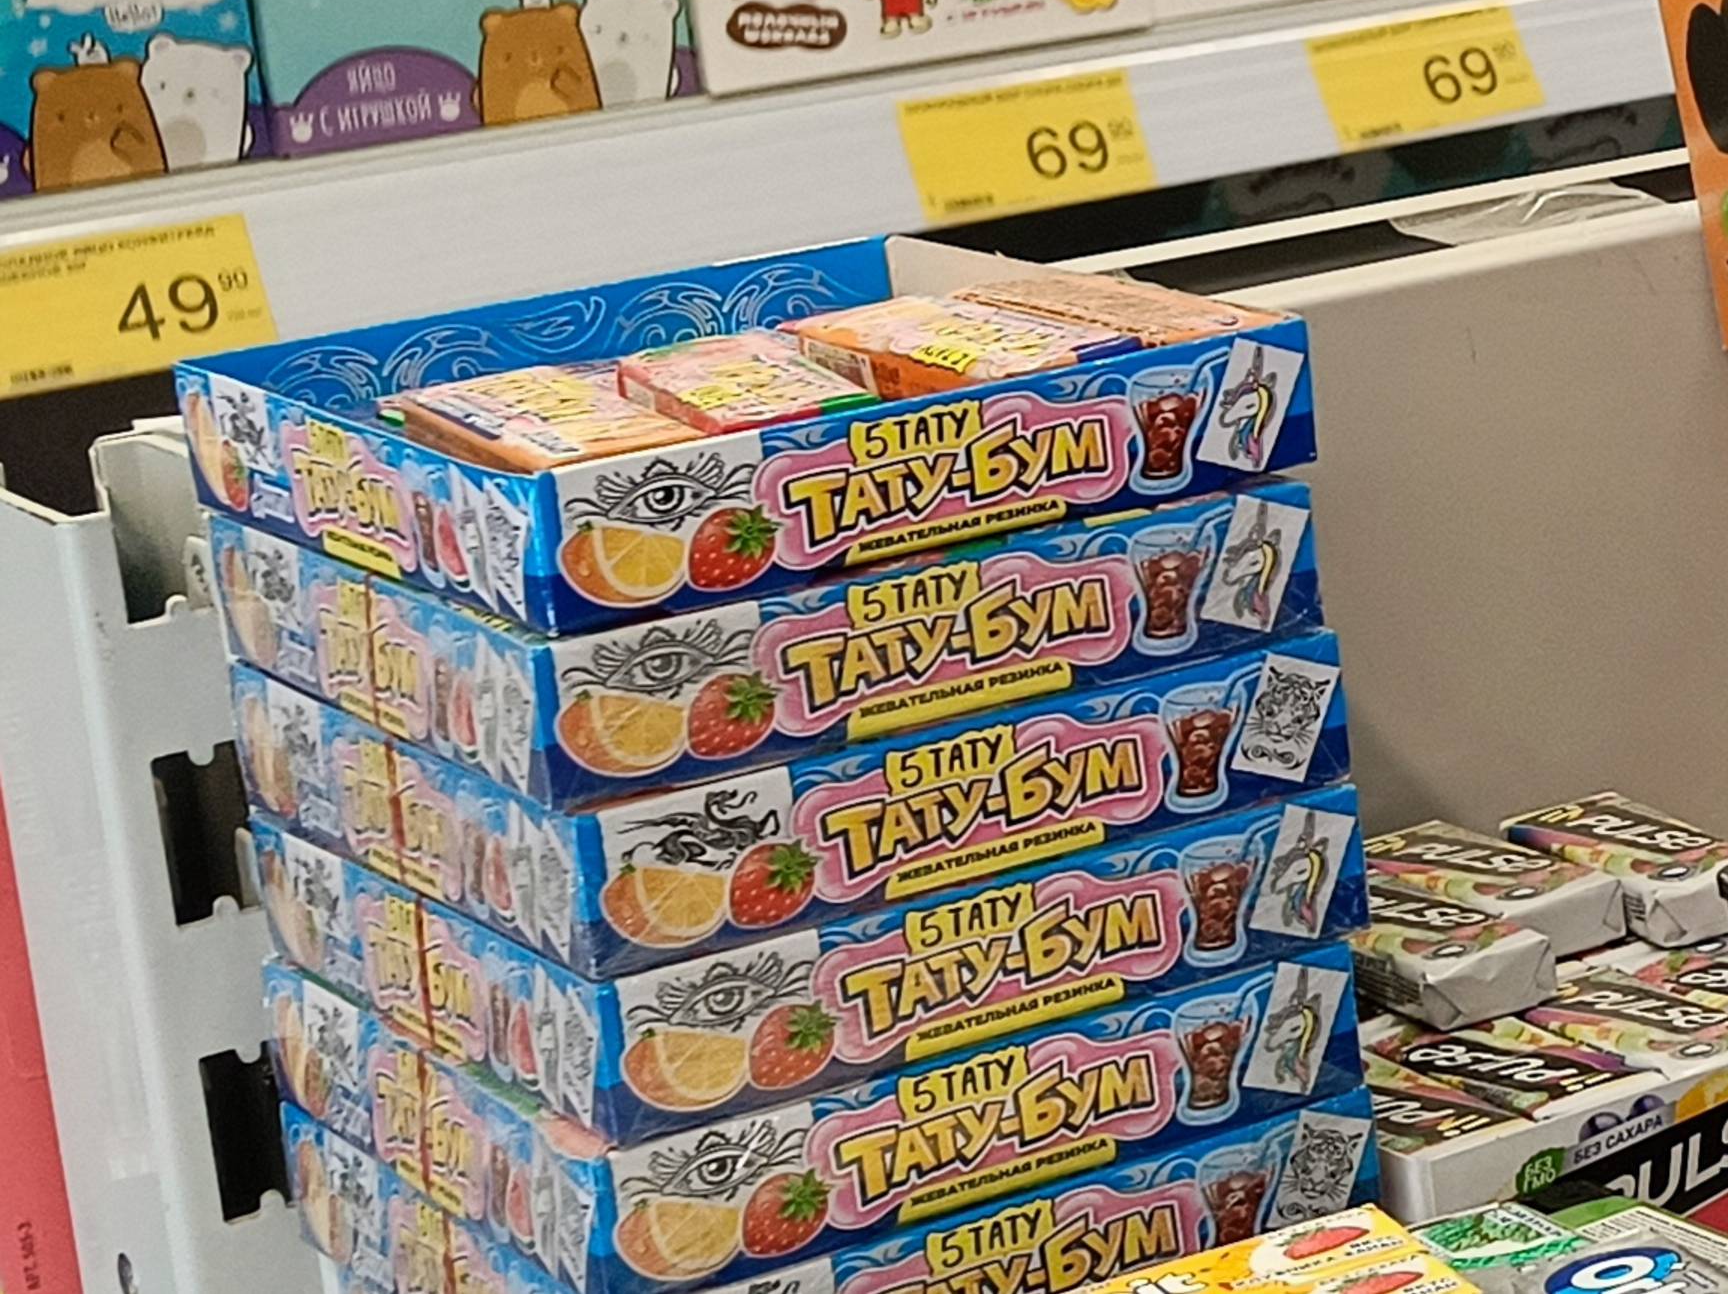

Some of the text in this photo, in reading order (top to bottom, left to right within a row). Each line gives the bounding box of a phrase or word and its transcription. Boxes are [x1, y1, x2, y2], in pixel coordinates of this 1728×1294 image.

[347, 62, 396, 95] ЯЙЦО
[1423, 47, 1499, 106] 69
[337, 90, 433, 134] ИГРУШКОЙ
[1026, 122, 1111, 180] 69
[118, 273, 218, 340] 49
[864, 407, 973, 457] 5 ТАТУ
[784, 416, 1106, 547] ТАТУ-БУМ
[857, 499, 1062, 553] ЖЕВАТЕЛЬНАЯ РЕЗИНКА
[862, 568, 972, 620] 5 ТАТУ
[782, 576, 1106, 712] ТАТУ-БУМ
[857, 662, 1065, 719] ЖЕВАТЕЛЬНАЯ РЕЗИНКА
[897, 736, 1004, 788] 5 ТАТУ
[821, 739, 1144, 879] ТАТУ-БУМ
[895, 820, 1099, 884] ЖЕВАТЕЛЬНАЯ РЕЗИНКА
[918, 895, 1023, 946] 5 ТАТУ
[840, 894, 1160, 1040] ТАТУ-БУМ
[916, 978, 1116, 1042] ЖЕВАТЕЛЬНАЯ РЕЗИНКА
[912, 1060, 1018, 1111] 5 ТАТУ
[834, 1054, 1153, 1205] ТАТУ-БУМ
[1573, 1114, 1663, 1165] БЕЗ САХАРА
[909, 1137, 1109, 1206] ЖЕВАТЕЛЬНАЯ РЕЗИНКА
[939, 1211, 1044, 1268] 5 ТАТУ
